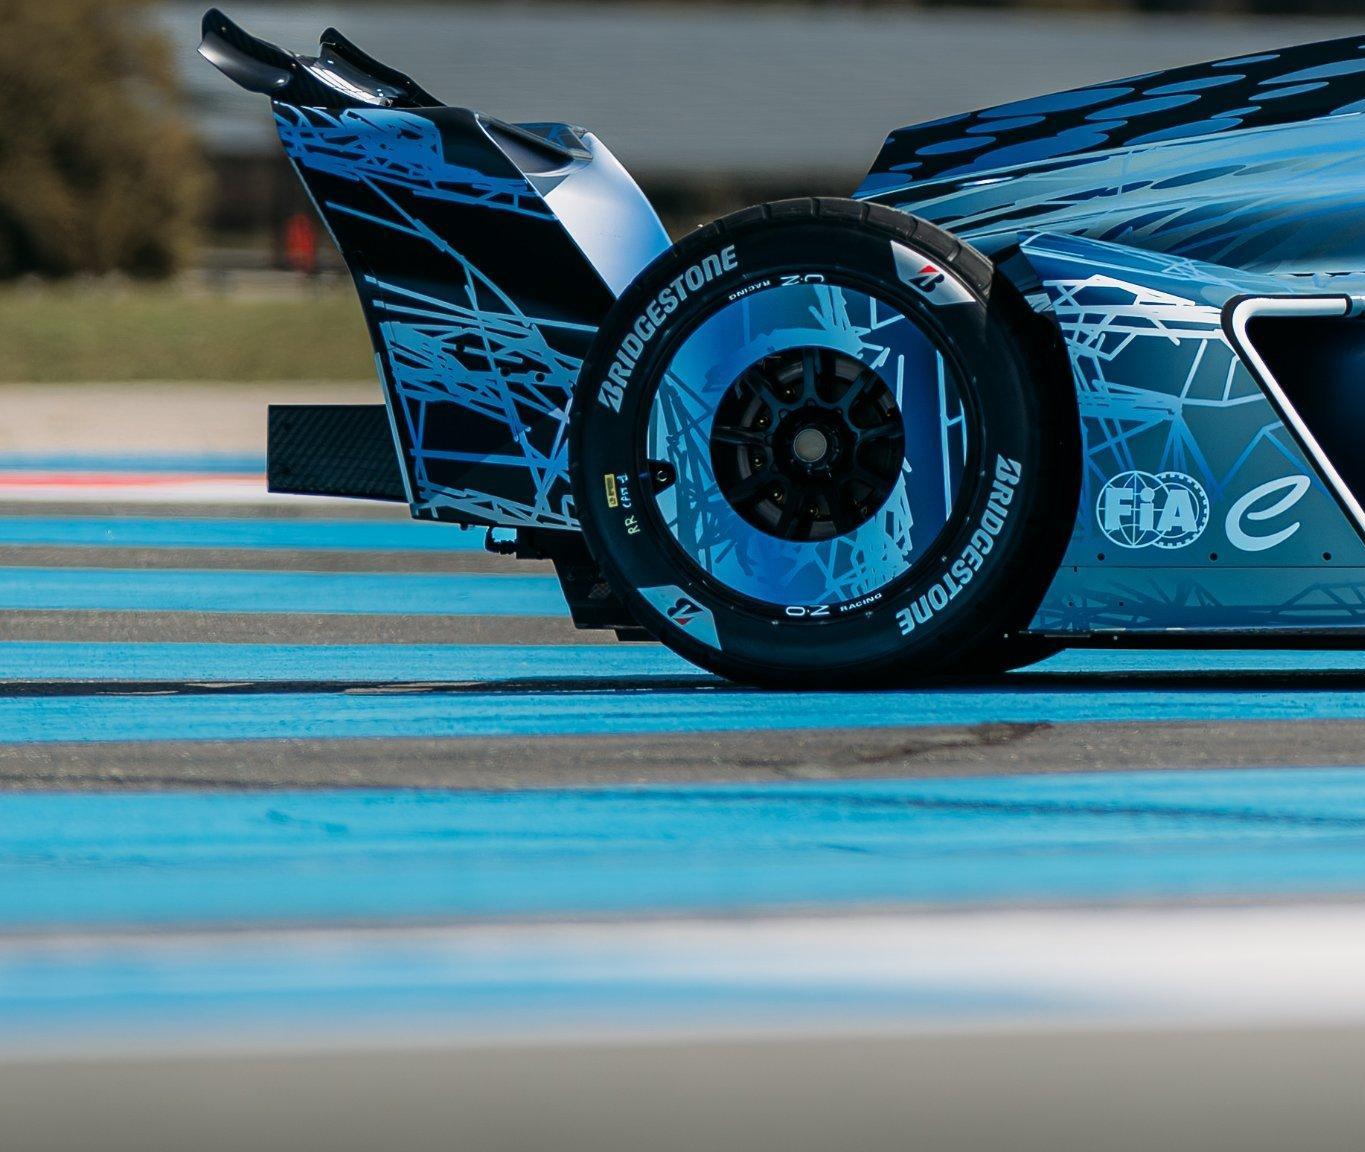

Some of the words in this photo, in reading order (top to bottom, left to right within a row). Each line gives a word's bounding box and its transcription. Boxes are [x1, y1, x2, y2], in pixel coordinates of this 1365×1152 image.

[728, 279, 771, 301] RACING
[597, 243, 738, 414] BRIDGESTONE
[624, 515, 641, 535] RR
[895, 452, 1022, 637] BRIDGESTONE
[839, 592, 883, 612] RACING
